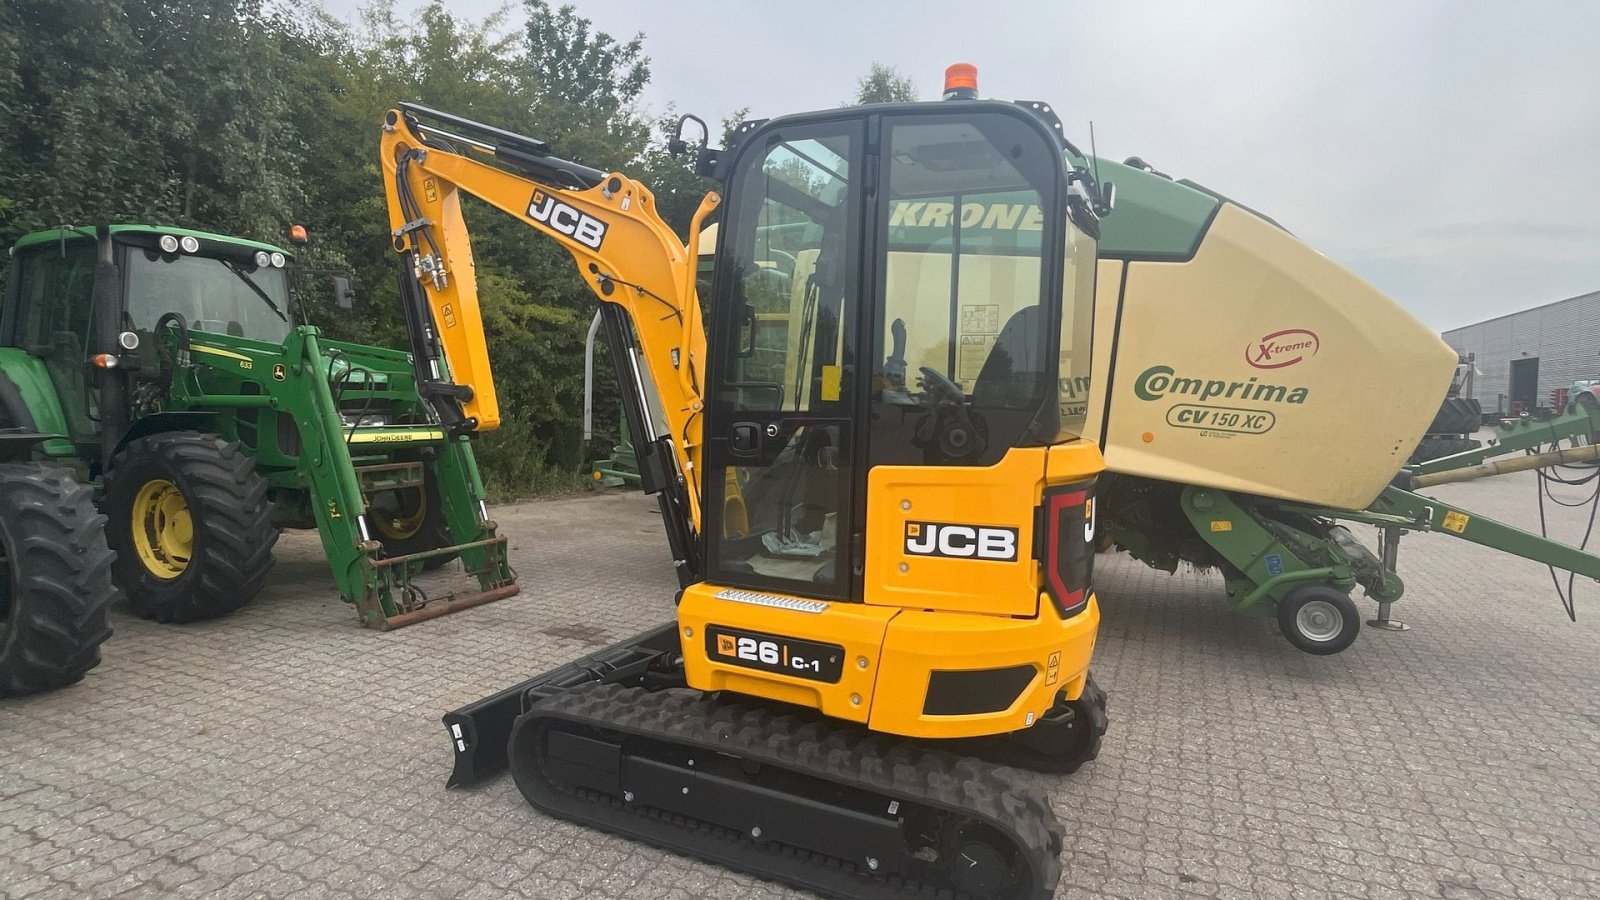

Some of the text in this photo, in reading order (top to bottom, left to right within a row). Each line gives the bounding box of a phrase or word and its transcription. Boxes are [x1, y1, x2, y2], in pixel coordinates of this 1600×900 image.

[529, 197, 605, 248] JCB
[889, 202, 1044, 231] KRONE
[240, 360, 253, 369] 633
[1254, 341, 1312, 362] X-treme
[1134, 365, 1309, 404] Comprima
[1177, 409, 1267, 430] CV 150 XC
[907, 525, 1015, 559] JCB
[737, 637, 779, 665] 26
[791, 656, 820, 673] C-1
